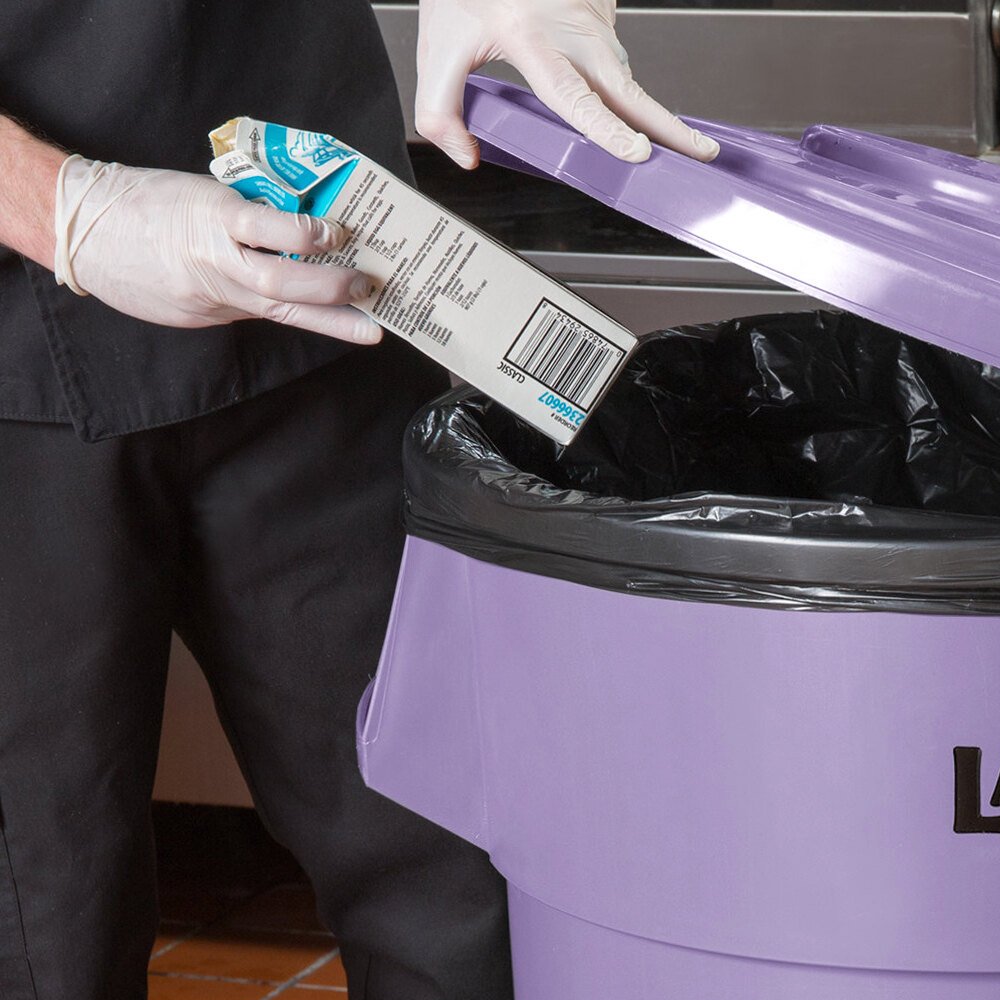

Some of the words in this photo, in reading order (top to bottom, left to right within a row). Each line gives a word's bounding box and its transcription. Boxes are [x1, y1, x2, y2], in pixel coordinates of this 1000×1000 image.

[555, 312, 582, 332] 29434
[582, 329, 607, 350] 74865
[496, 361, 525, 383] CLASSIC
[537, 391, 585, 426] 2366607
[553, 414, 578, 432] REORDER
